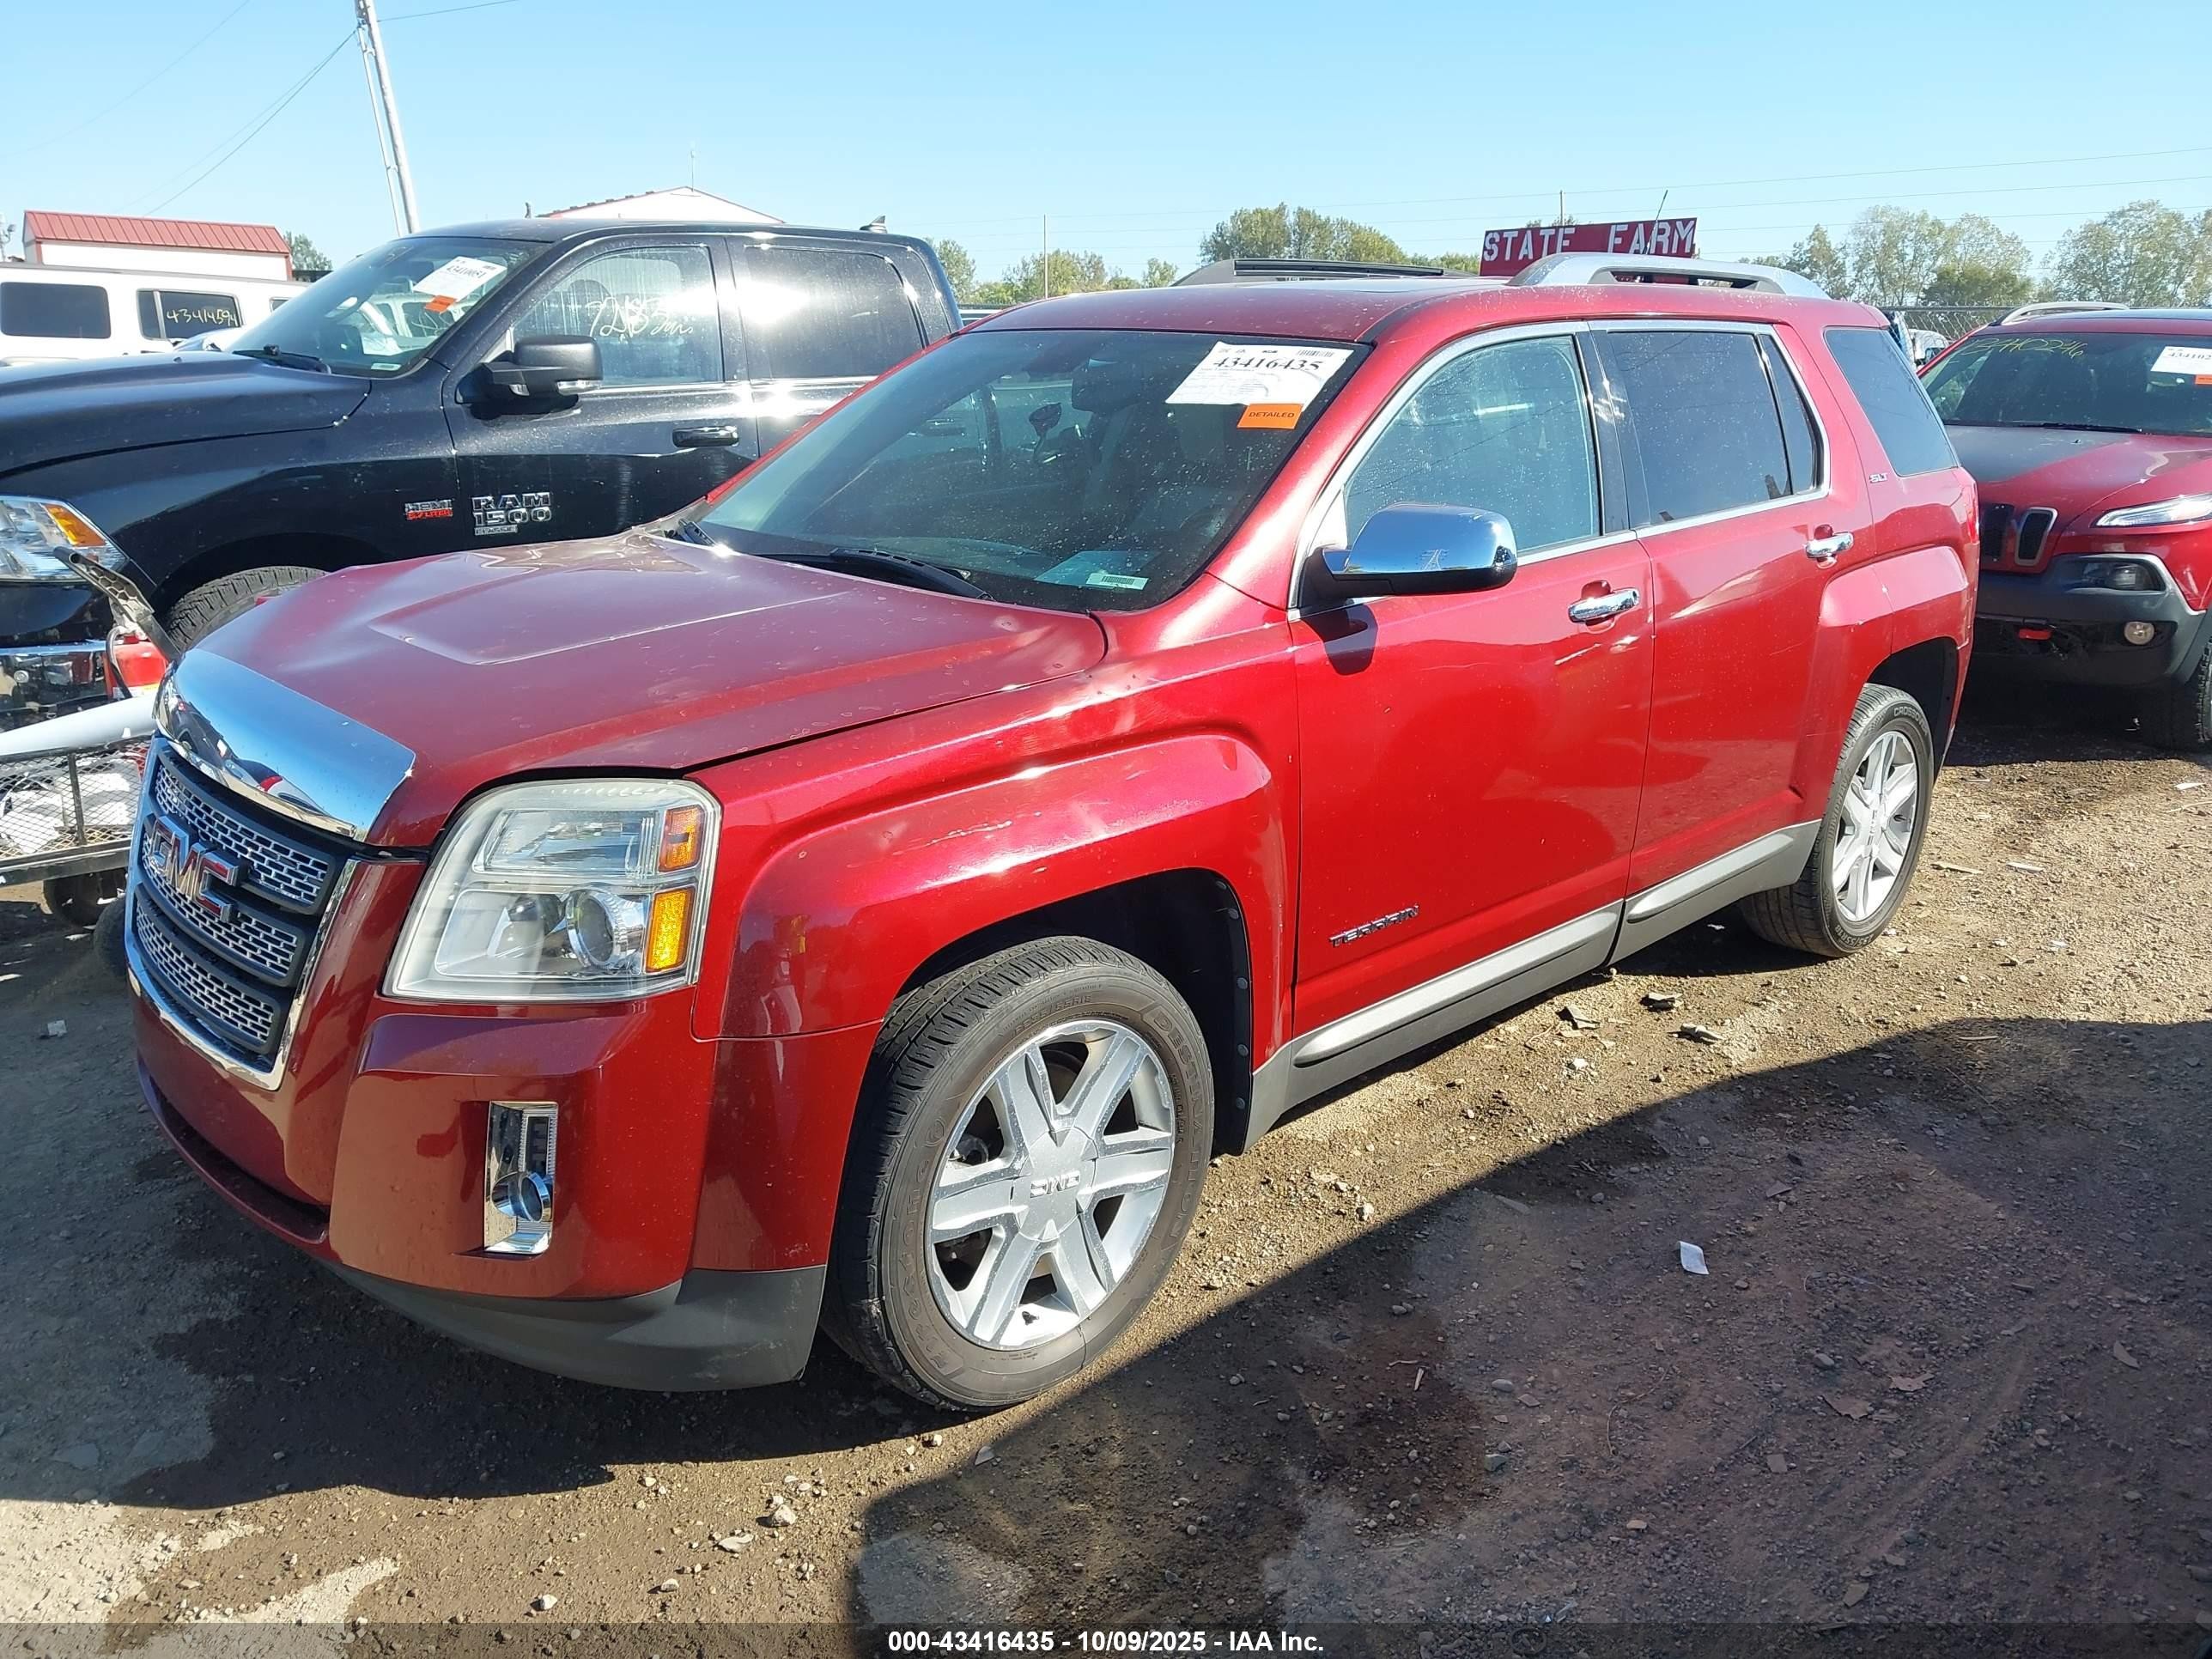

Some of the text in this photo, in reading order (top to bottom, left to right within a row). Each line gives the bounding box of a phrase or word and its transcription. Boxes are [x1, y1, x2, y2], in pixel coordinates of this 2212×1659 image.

[1484, 220, 1695, 262] STATE FARM
[166, 308, 240, 327] 43414594
[1212, 356, 1326, 372] 43416435
[1869, 473, 1888, 483] SLT
[471, 491, 552, 512] RAM
[473, 507, 552, 527] 1500
[149, 816, 239, 923] GMC
[1328, 905, 1419, 947] TERRAIN
